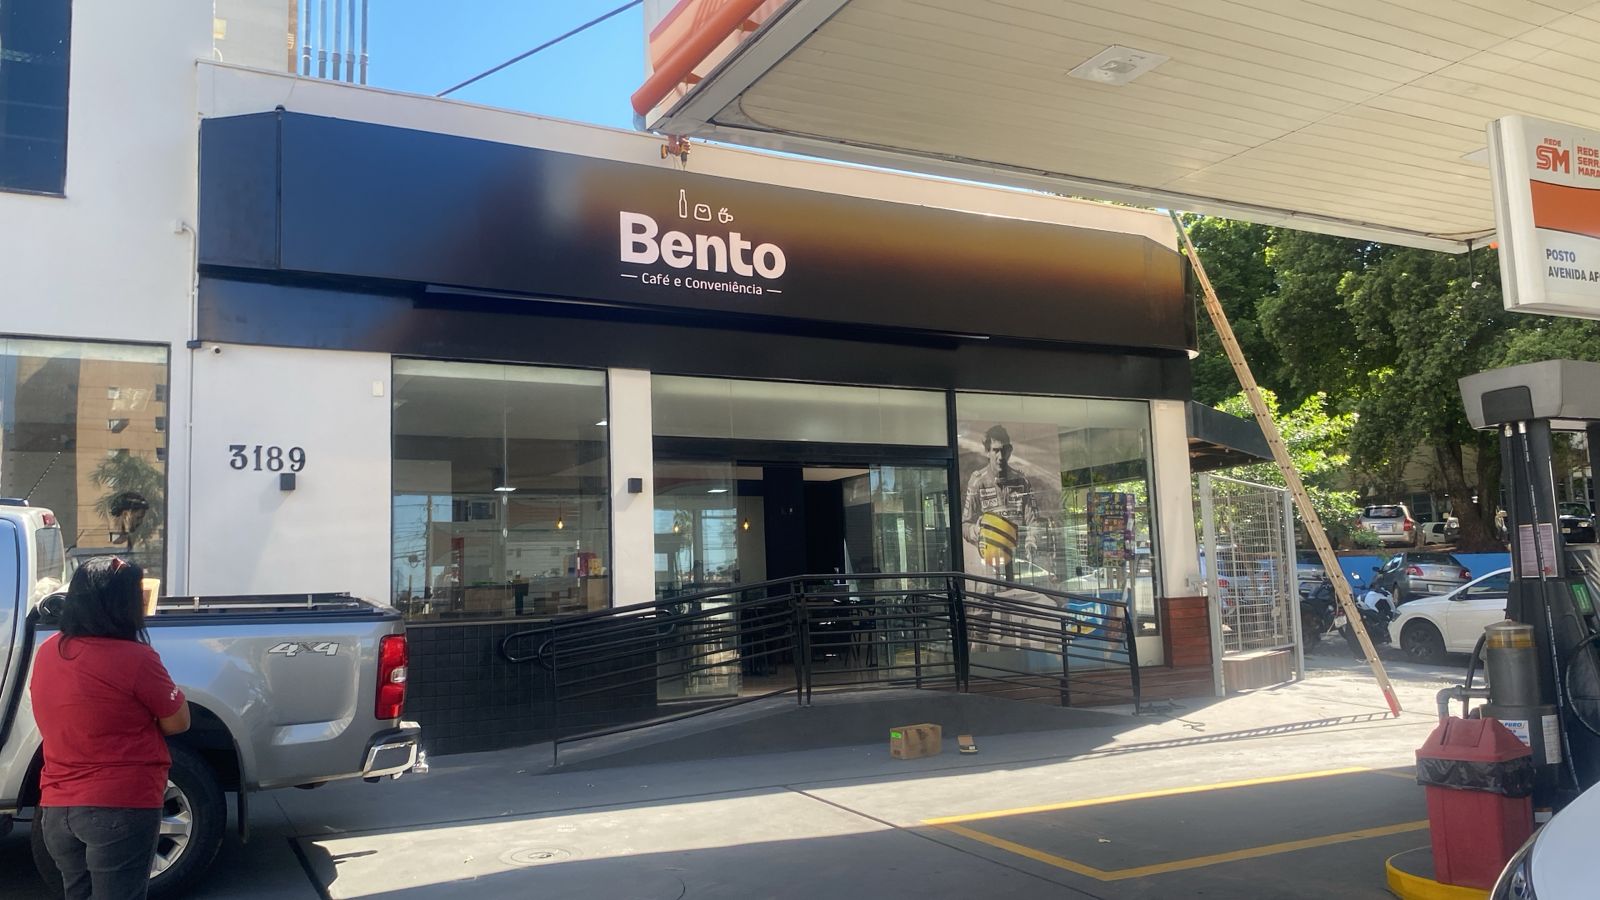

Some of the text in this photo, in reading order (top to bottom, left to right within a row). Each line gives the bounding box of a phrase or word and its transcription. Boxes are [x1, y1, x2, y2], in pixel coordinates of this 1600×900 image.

[1543, 137, 1562, 147] REDE
[1536, 145, 1570, 174] SM
[1577, 145, 1600, 158] REDE
[1577, 157, 1600, 168] SERR
[620, 211, 787, 279] Bento
[1546, 248, 1576, 263] POSTO
[1548, 265, 1600, 282] AVENIDA AF
[641, 272, 763, 295] Café e Conveniência
[229, 445, 306, 472] 3189
